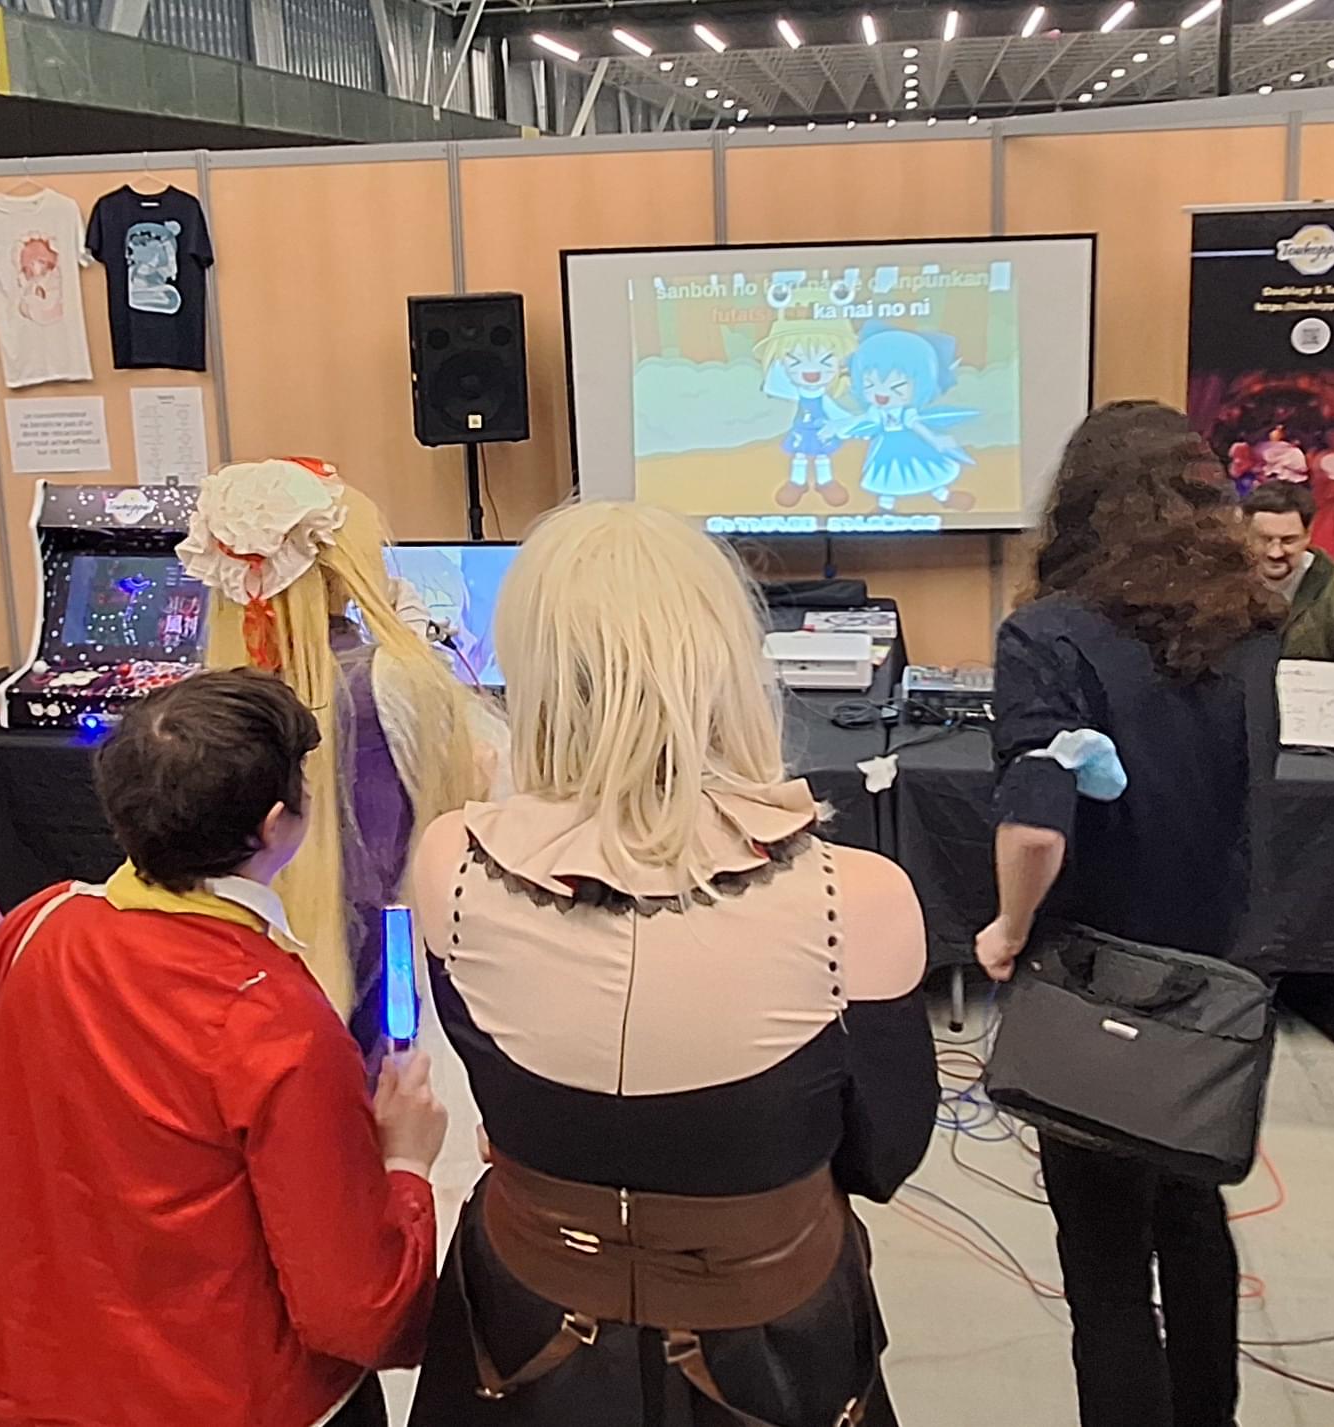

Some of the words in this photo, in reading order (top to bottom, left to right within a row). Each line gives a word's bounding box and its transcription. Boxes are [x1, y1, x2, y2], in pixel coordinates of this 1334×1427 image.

[842, 300, 874, 319] nai
[878, 302, 906, 317] no
[909, 297, 930, 316] ni
